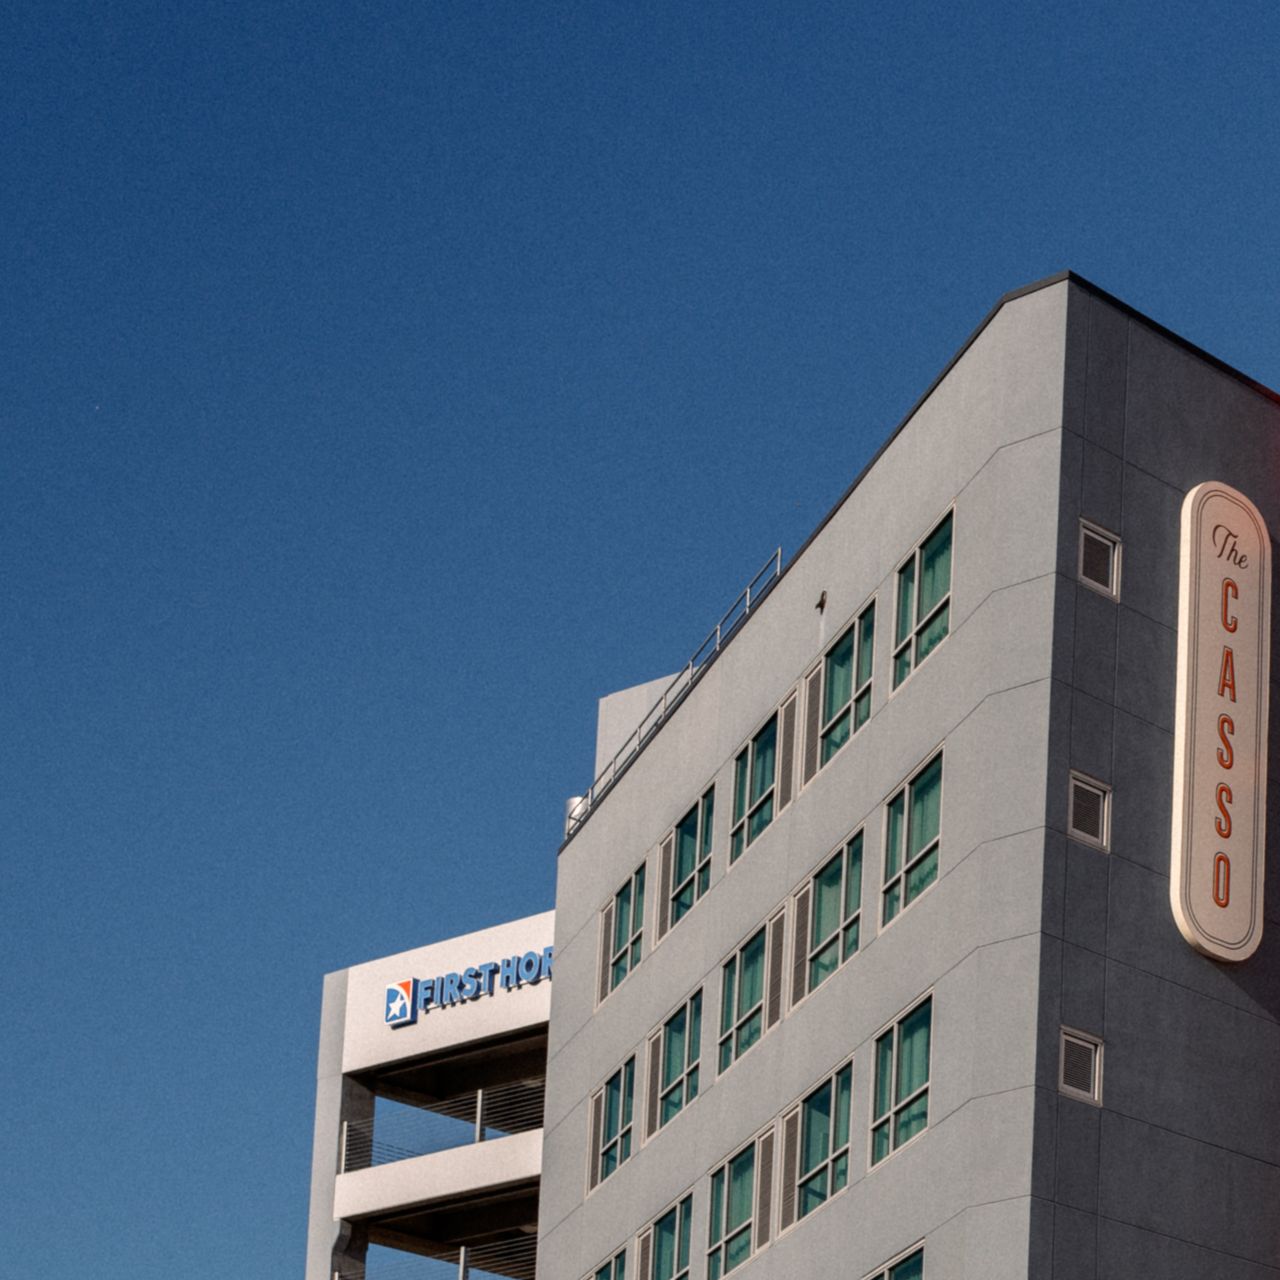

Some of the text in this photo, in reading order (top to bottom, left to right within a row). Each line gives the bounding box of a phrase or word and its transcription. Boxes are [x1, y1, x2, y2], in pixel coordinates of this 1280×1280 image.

[1211, 523, 1249, 570] The
[1212, 577, 1240, 909] CASSO
[417, 962, 497, 1010] FIRST
